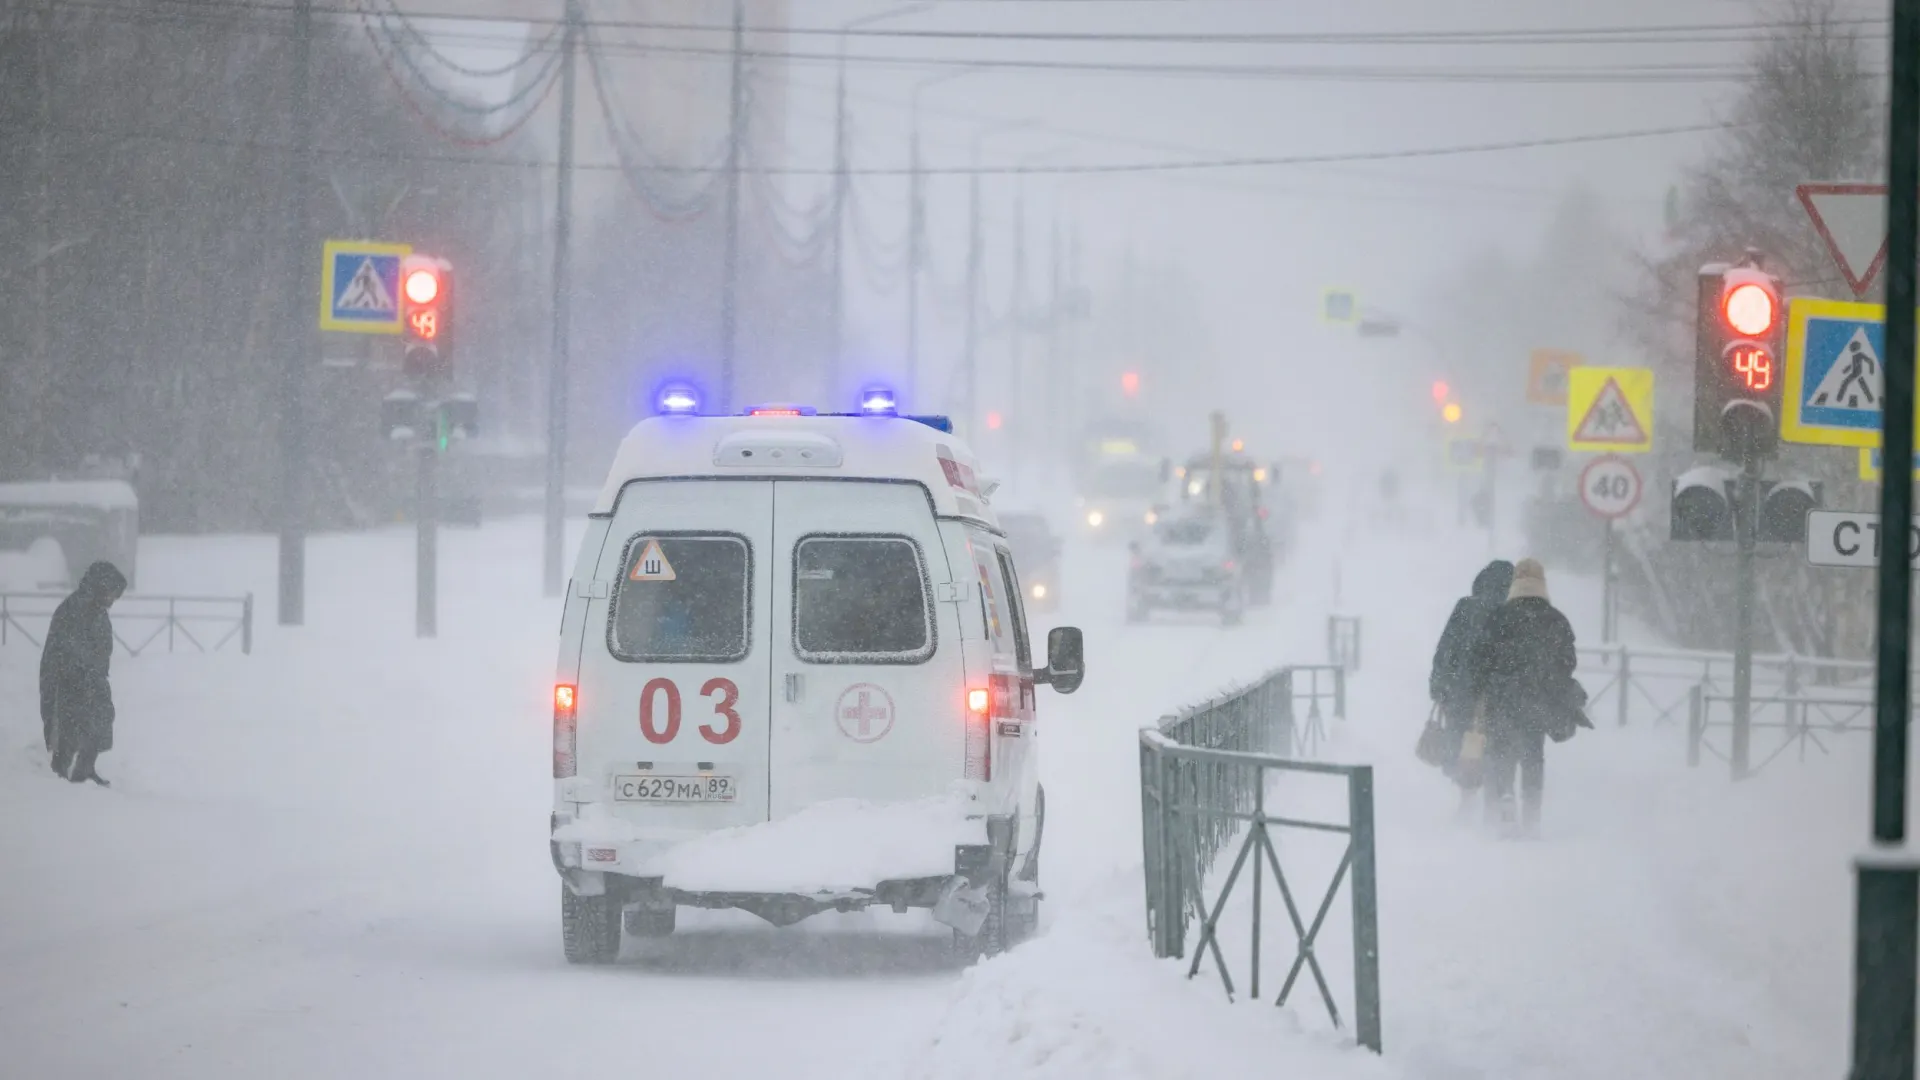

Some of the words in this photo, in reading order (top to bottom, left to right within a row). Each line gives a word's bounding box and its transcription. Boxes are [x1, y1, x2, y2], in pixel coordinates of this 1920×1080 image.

[412, 312, 436, 337] 49
[1735, 350, 1770, 389] 49
[1591, 474, 1629, 501] 40
[645, 559, 661, 575] Ш
[639, 677, 742, 745] 03
[622, 778, 702, 799] С629МА
[708, 778, 729, 793] 89
